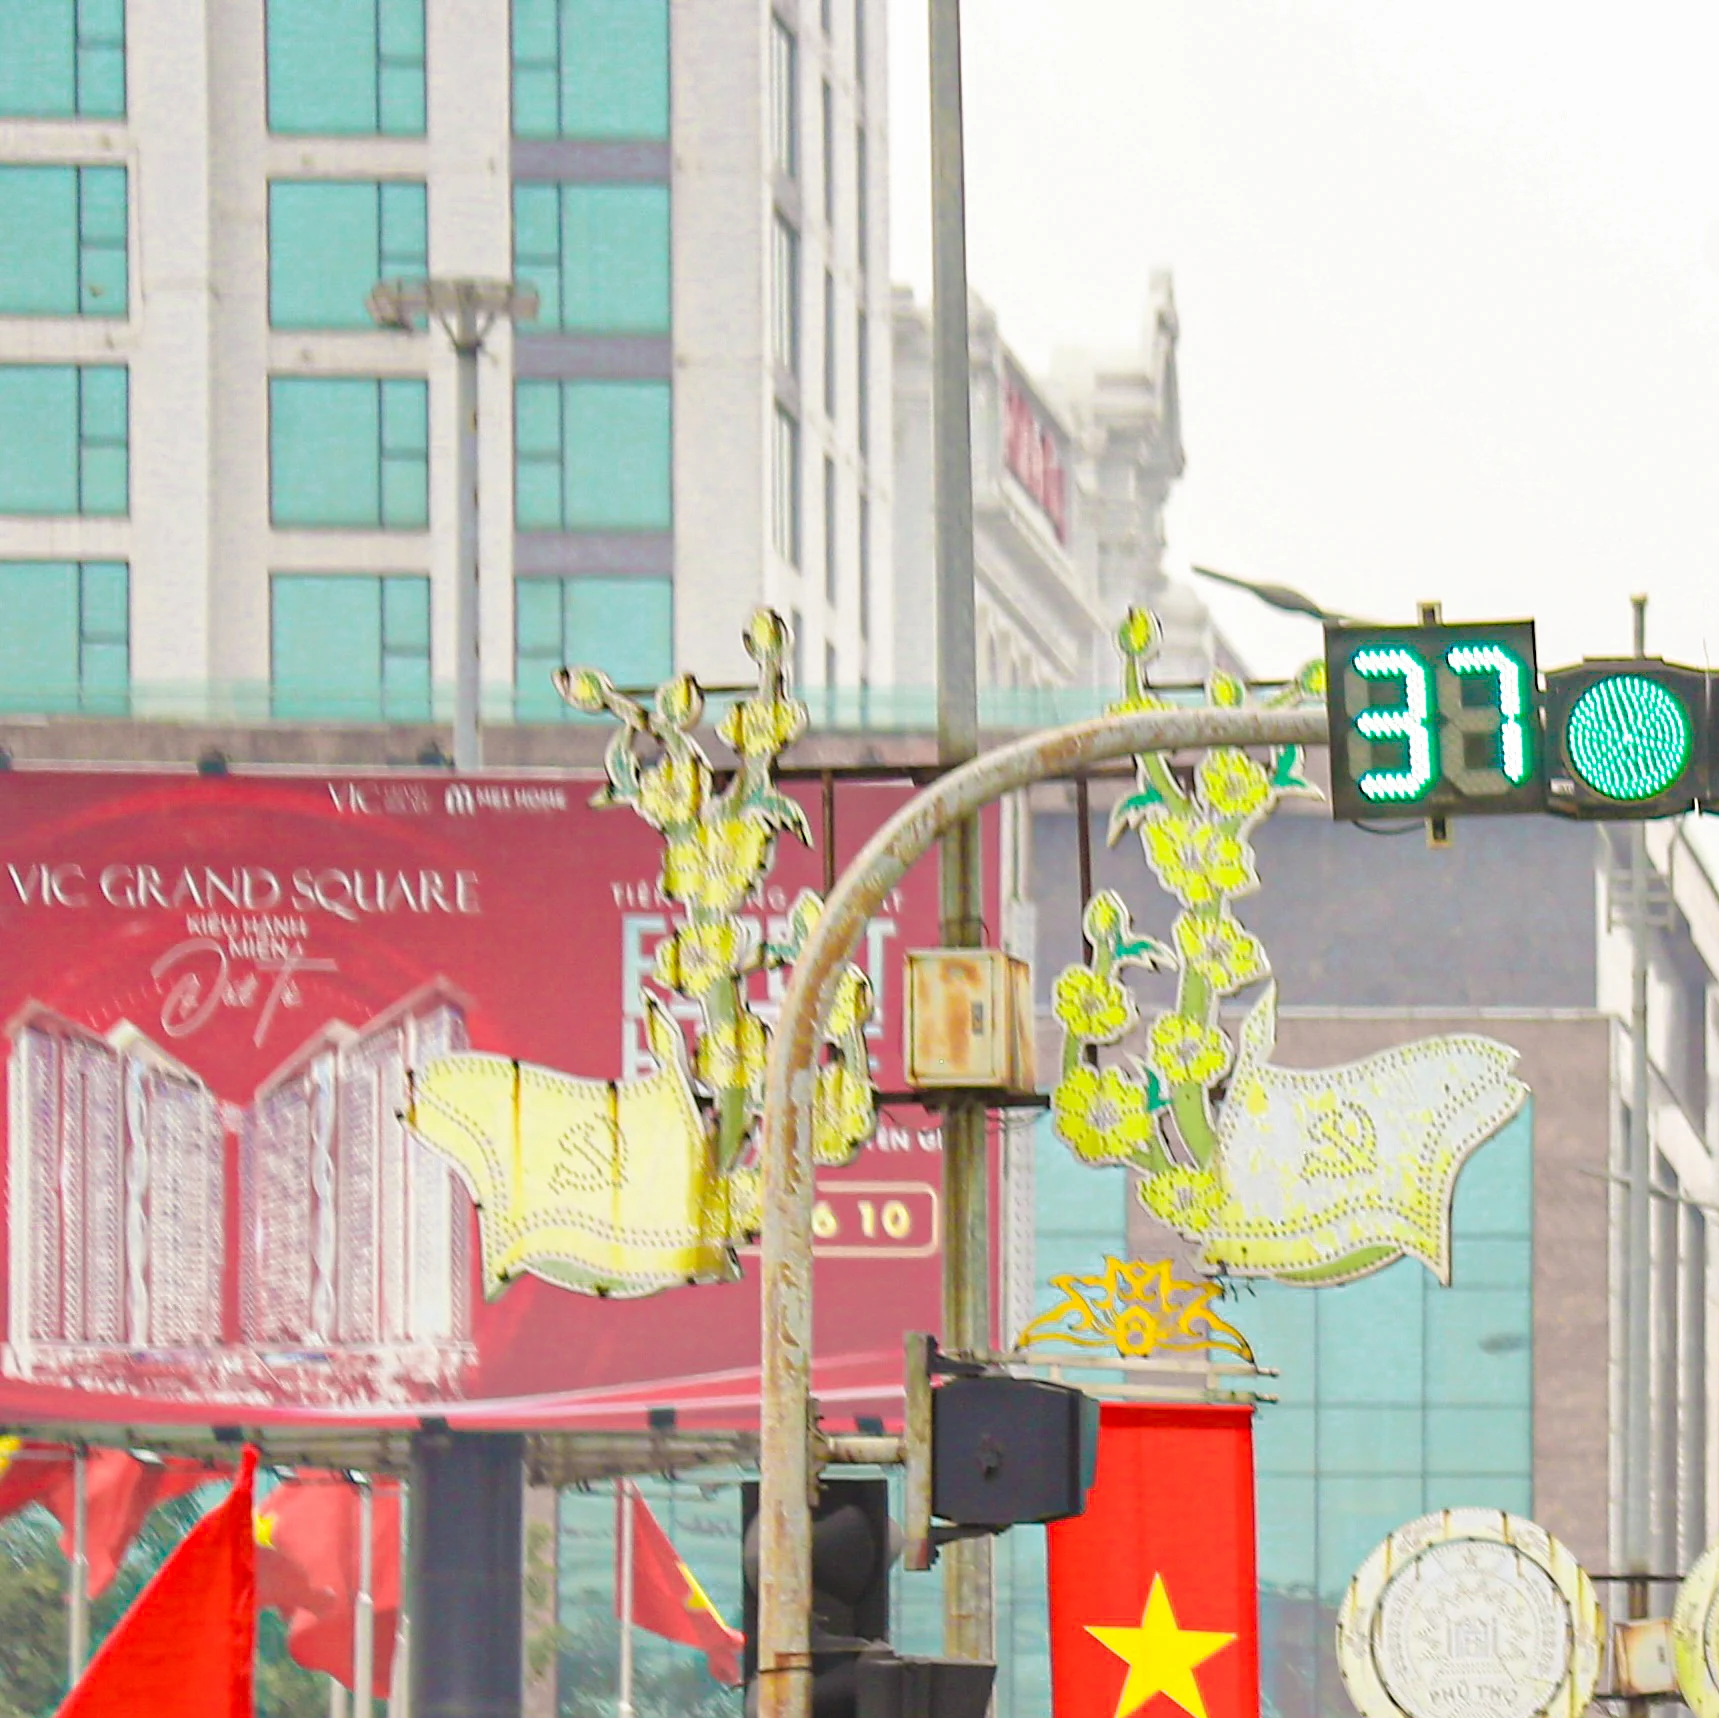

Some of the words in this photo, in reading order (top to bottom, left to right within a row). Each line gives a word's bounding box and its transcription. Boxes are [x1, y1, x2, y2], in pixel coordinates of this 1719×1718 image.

[1352, 647, 1527, 804] 37
[7, 863, 87, 907] VIC
[99, 864, 283, 910] GRAND
[291, 868, 482, 922] SQUARE
[857, 1200, 912, 1238] 10
